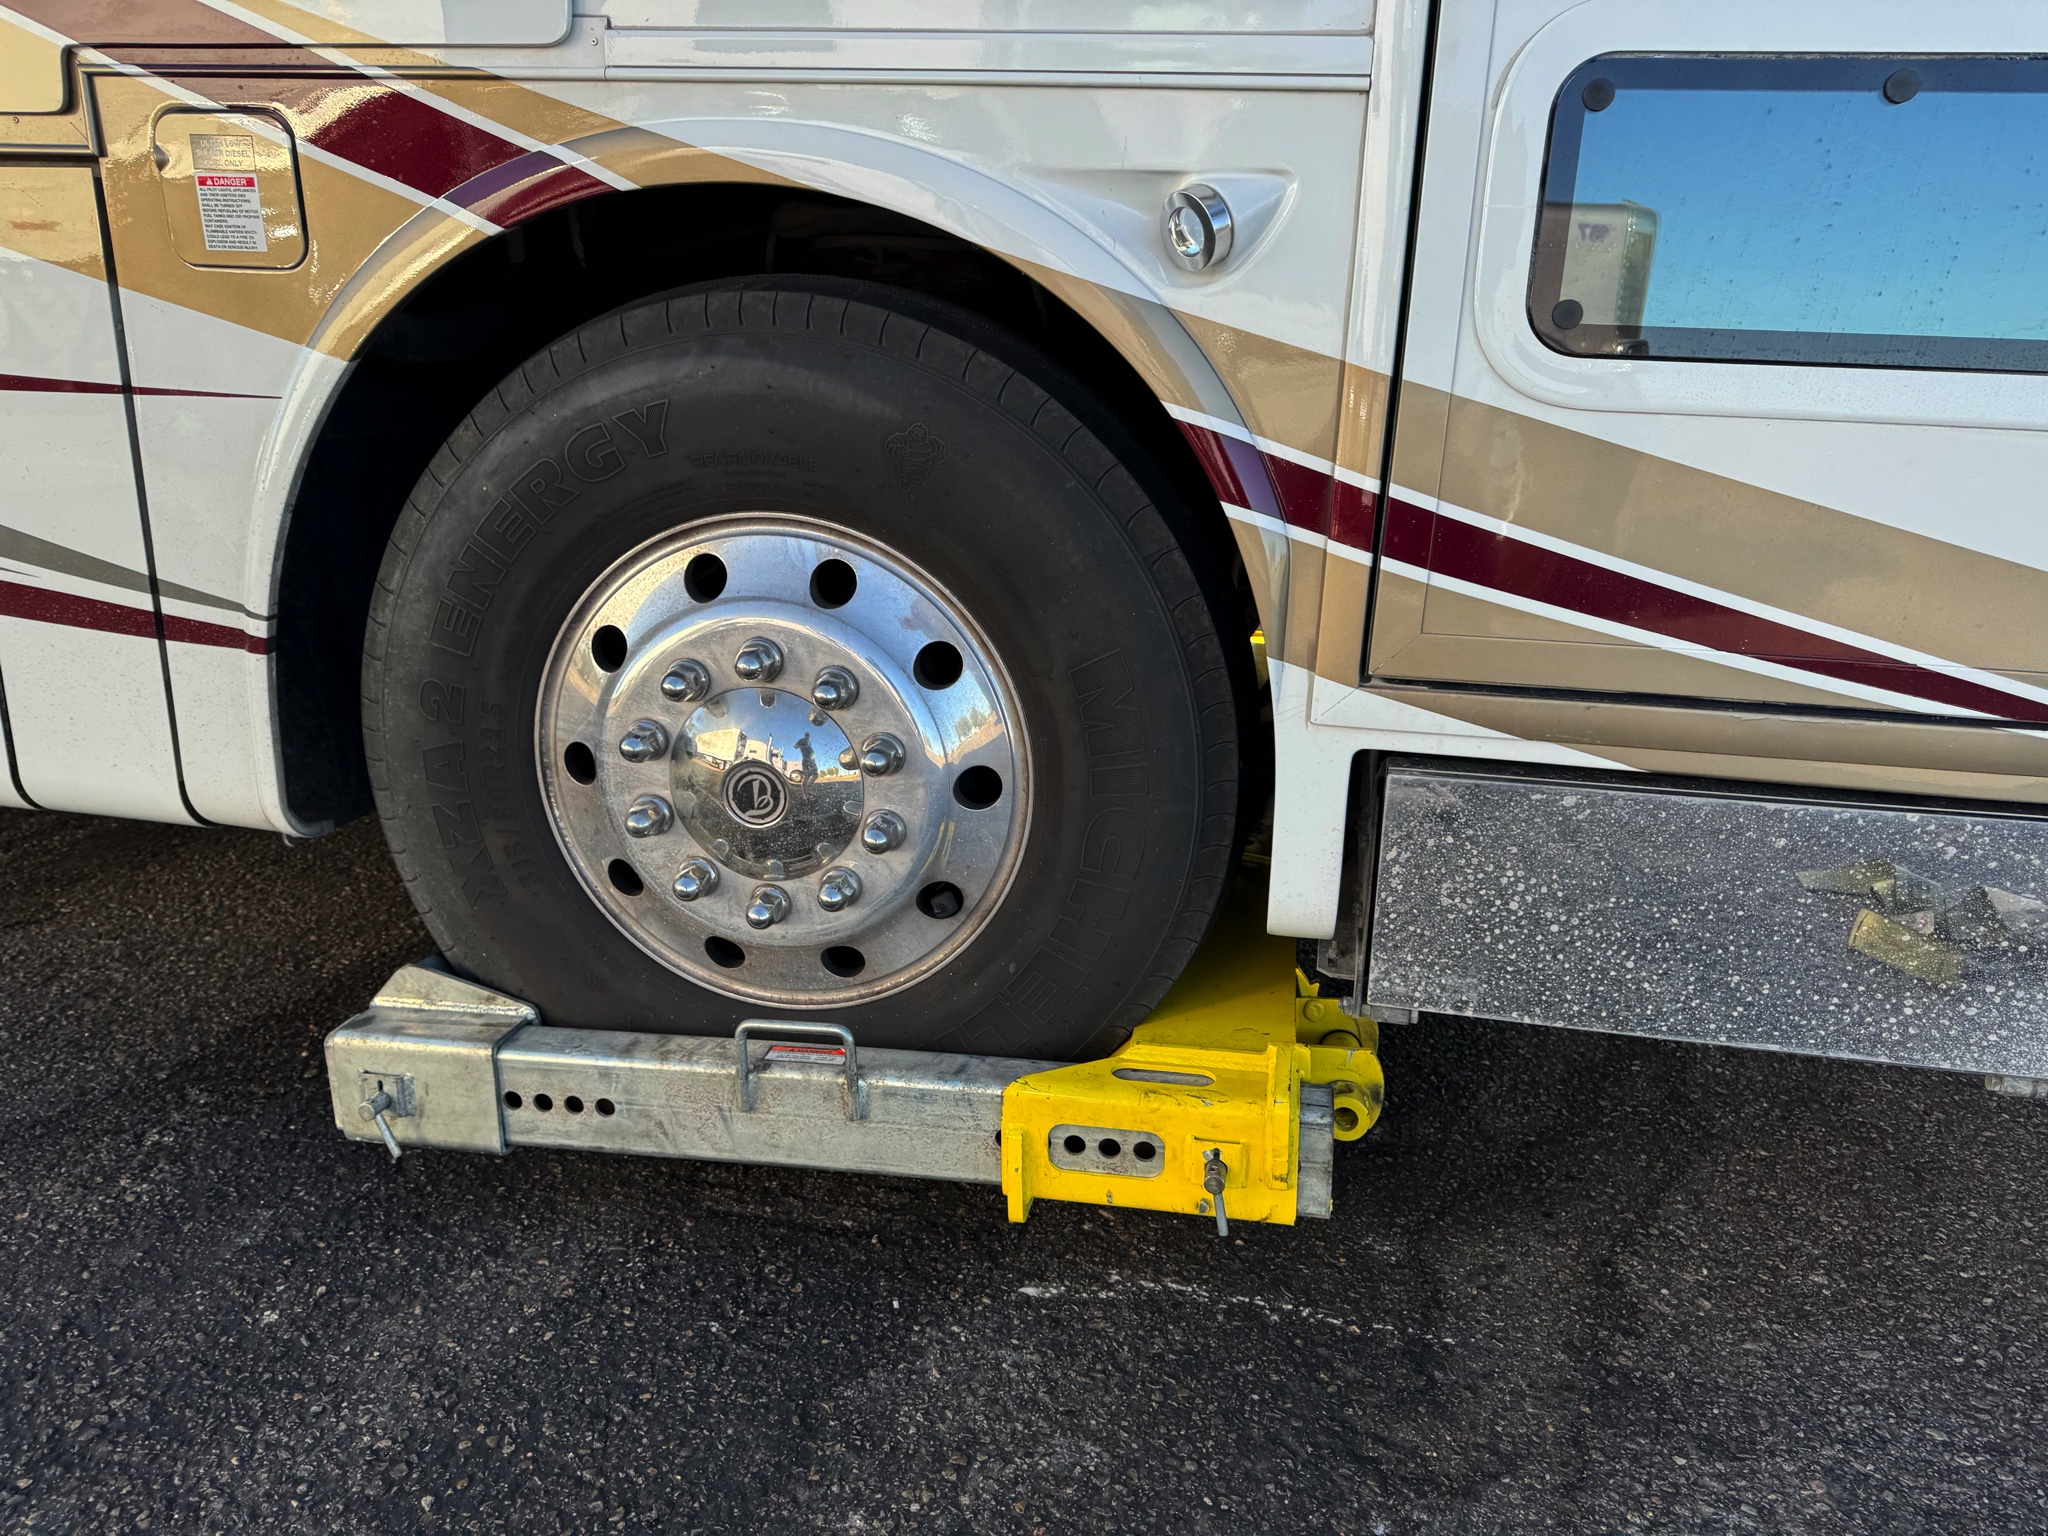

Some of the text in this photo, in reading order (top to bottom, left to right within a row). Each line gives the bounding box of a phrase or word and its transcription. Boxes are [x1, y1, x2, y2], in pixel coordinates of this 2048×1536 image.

[224, 159, 243, 167] ONLY
[225, 150, 250, 158] DIESEL
[213, 177, 247, 186] DANGER
[693, 451, 822, 472] REGROOVABLE
[427, 399, 670, 657] ENERGY
[479, 700, 546, 889] 315/80R22.5
[914, 648, 1148, 1053] MICHEL
